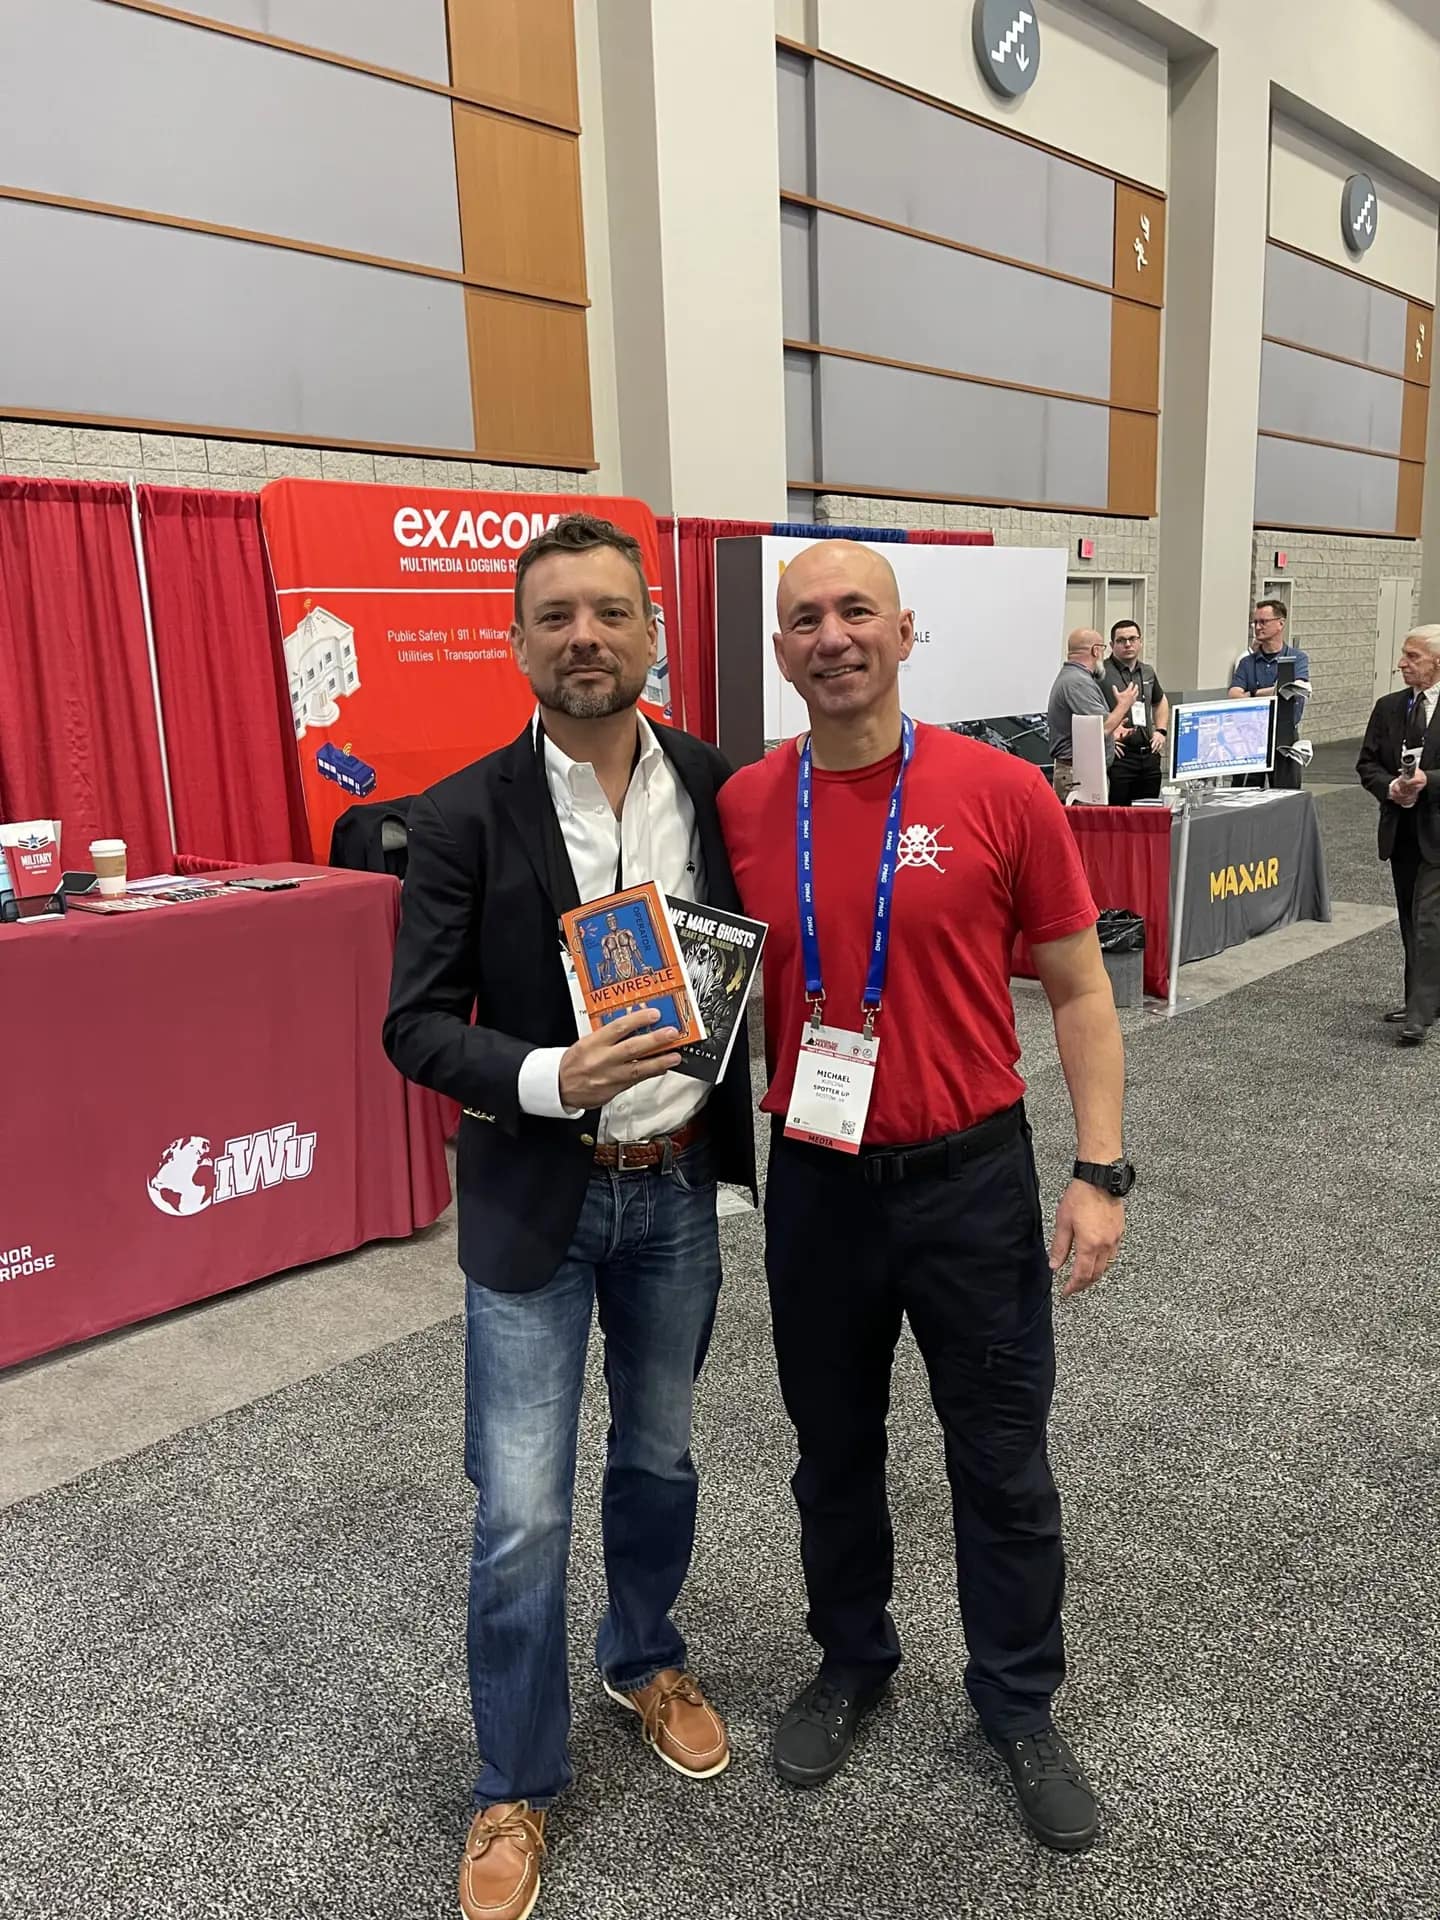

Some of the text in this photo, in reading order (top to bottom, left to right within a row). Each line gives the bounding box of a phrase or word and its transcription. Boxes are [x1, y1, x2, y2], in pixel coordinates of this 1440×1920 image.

[400, 557, 463, 572] MULTIMEDIA
[466, 558, 507, 573] LOGGING
[387, 628, 510, 643] Public Safety 911 Military
[398, 648, 507, 662] Utilities Transportation
[20, 852, 52, 866] MILITARY
[1210, 857, 1279, 904] MAXAR
[633, 906, 651, 951] OPERATOR
[669, 907, 757, 949] WE MAKE GHOSTS
[590, 988, 611, 1004] WE
[816, 1069, 850, 1083] MICHAEL
[808, 1135, 833, 1147] MEDIA
[213, 1122, 317, 1204] IWU
